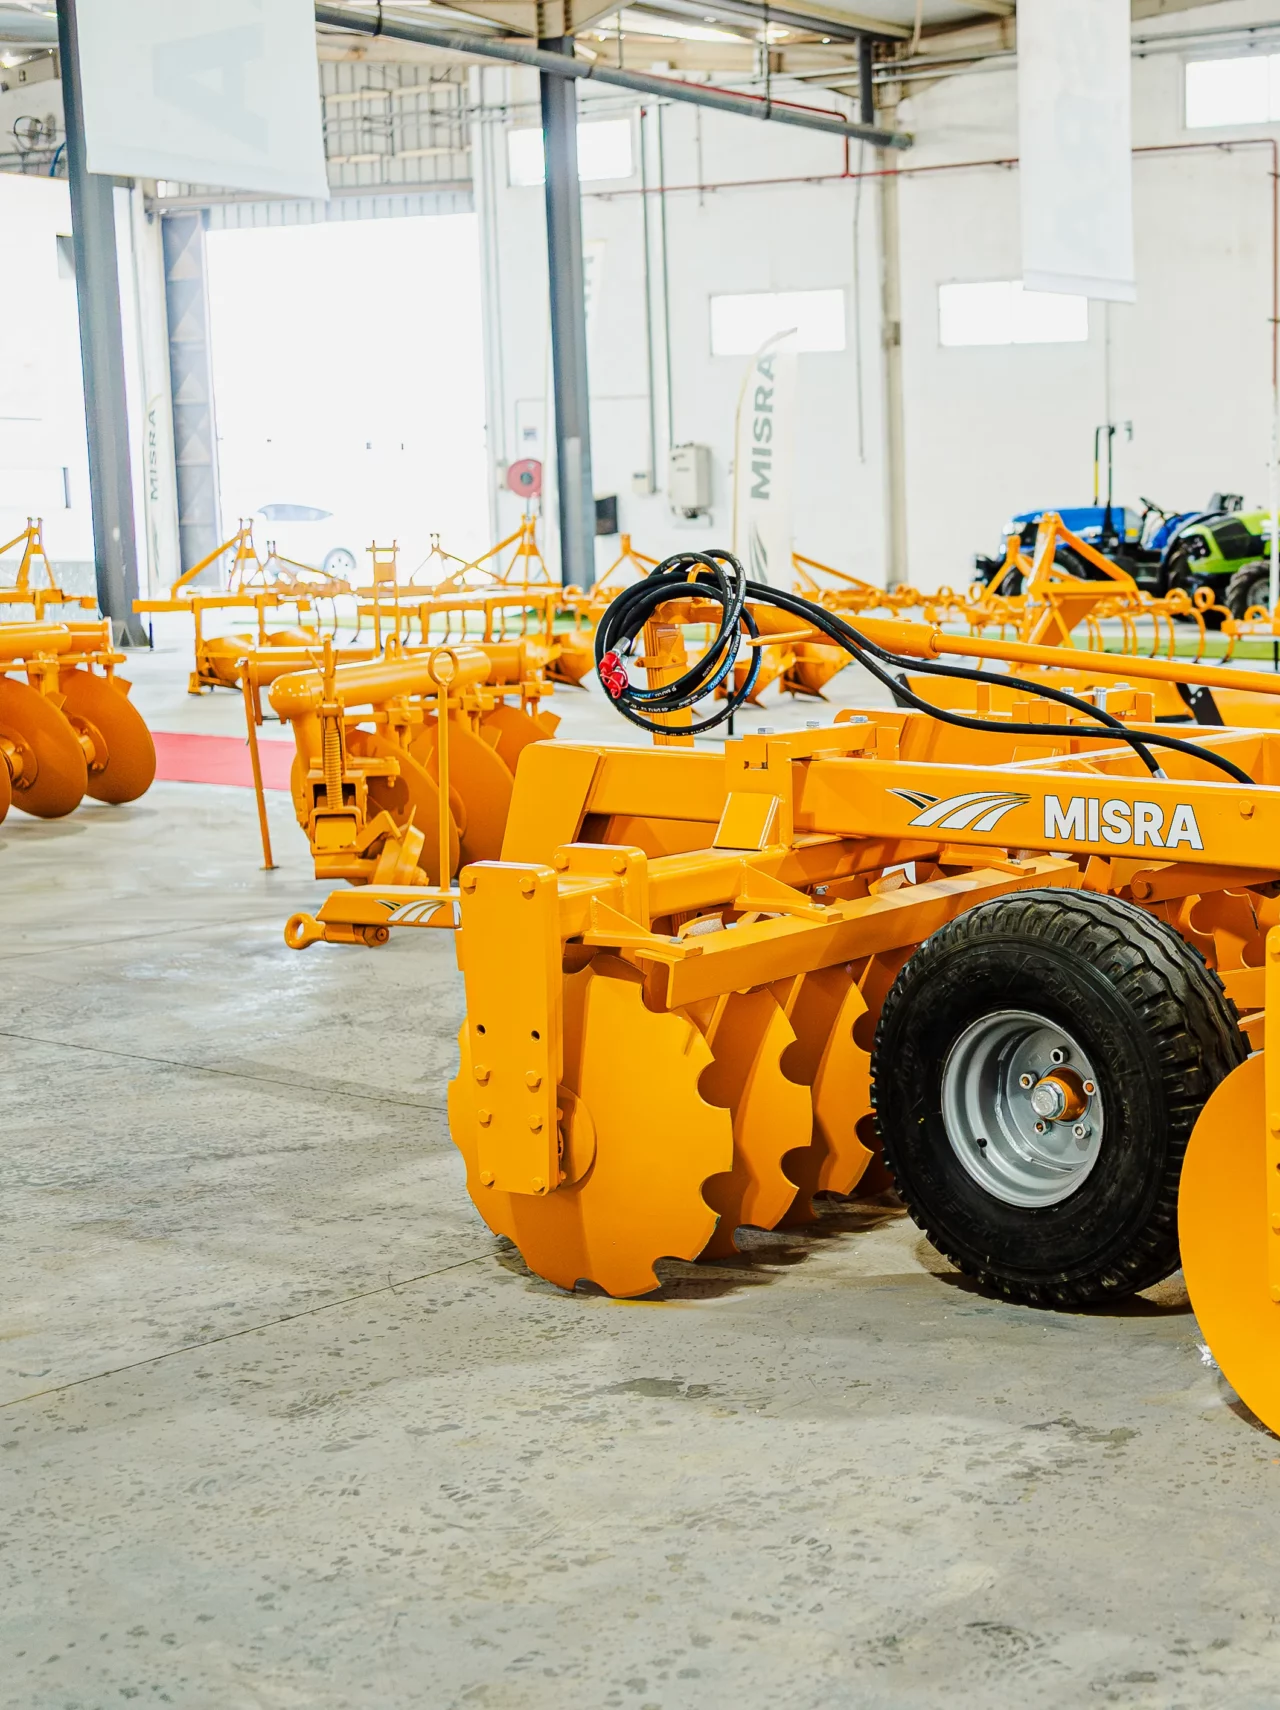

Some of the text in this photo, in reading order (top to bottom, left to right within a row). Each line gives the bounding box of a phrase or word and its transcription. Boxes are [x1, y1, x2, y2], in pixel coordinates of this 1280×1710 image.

[148, 408, 159, 500] MISRA
[750, 353, 776, 501] MISRA
[1044, 795, 1204, 850] MISRA
